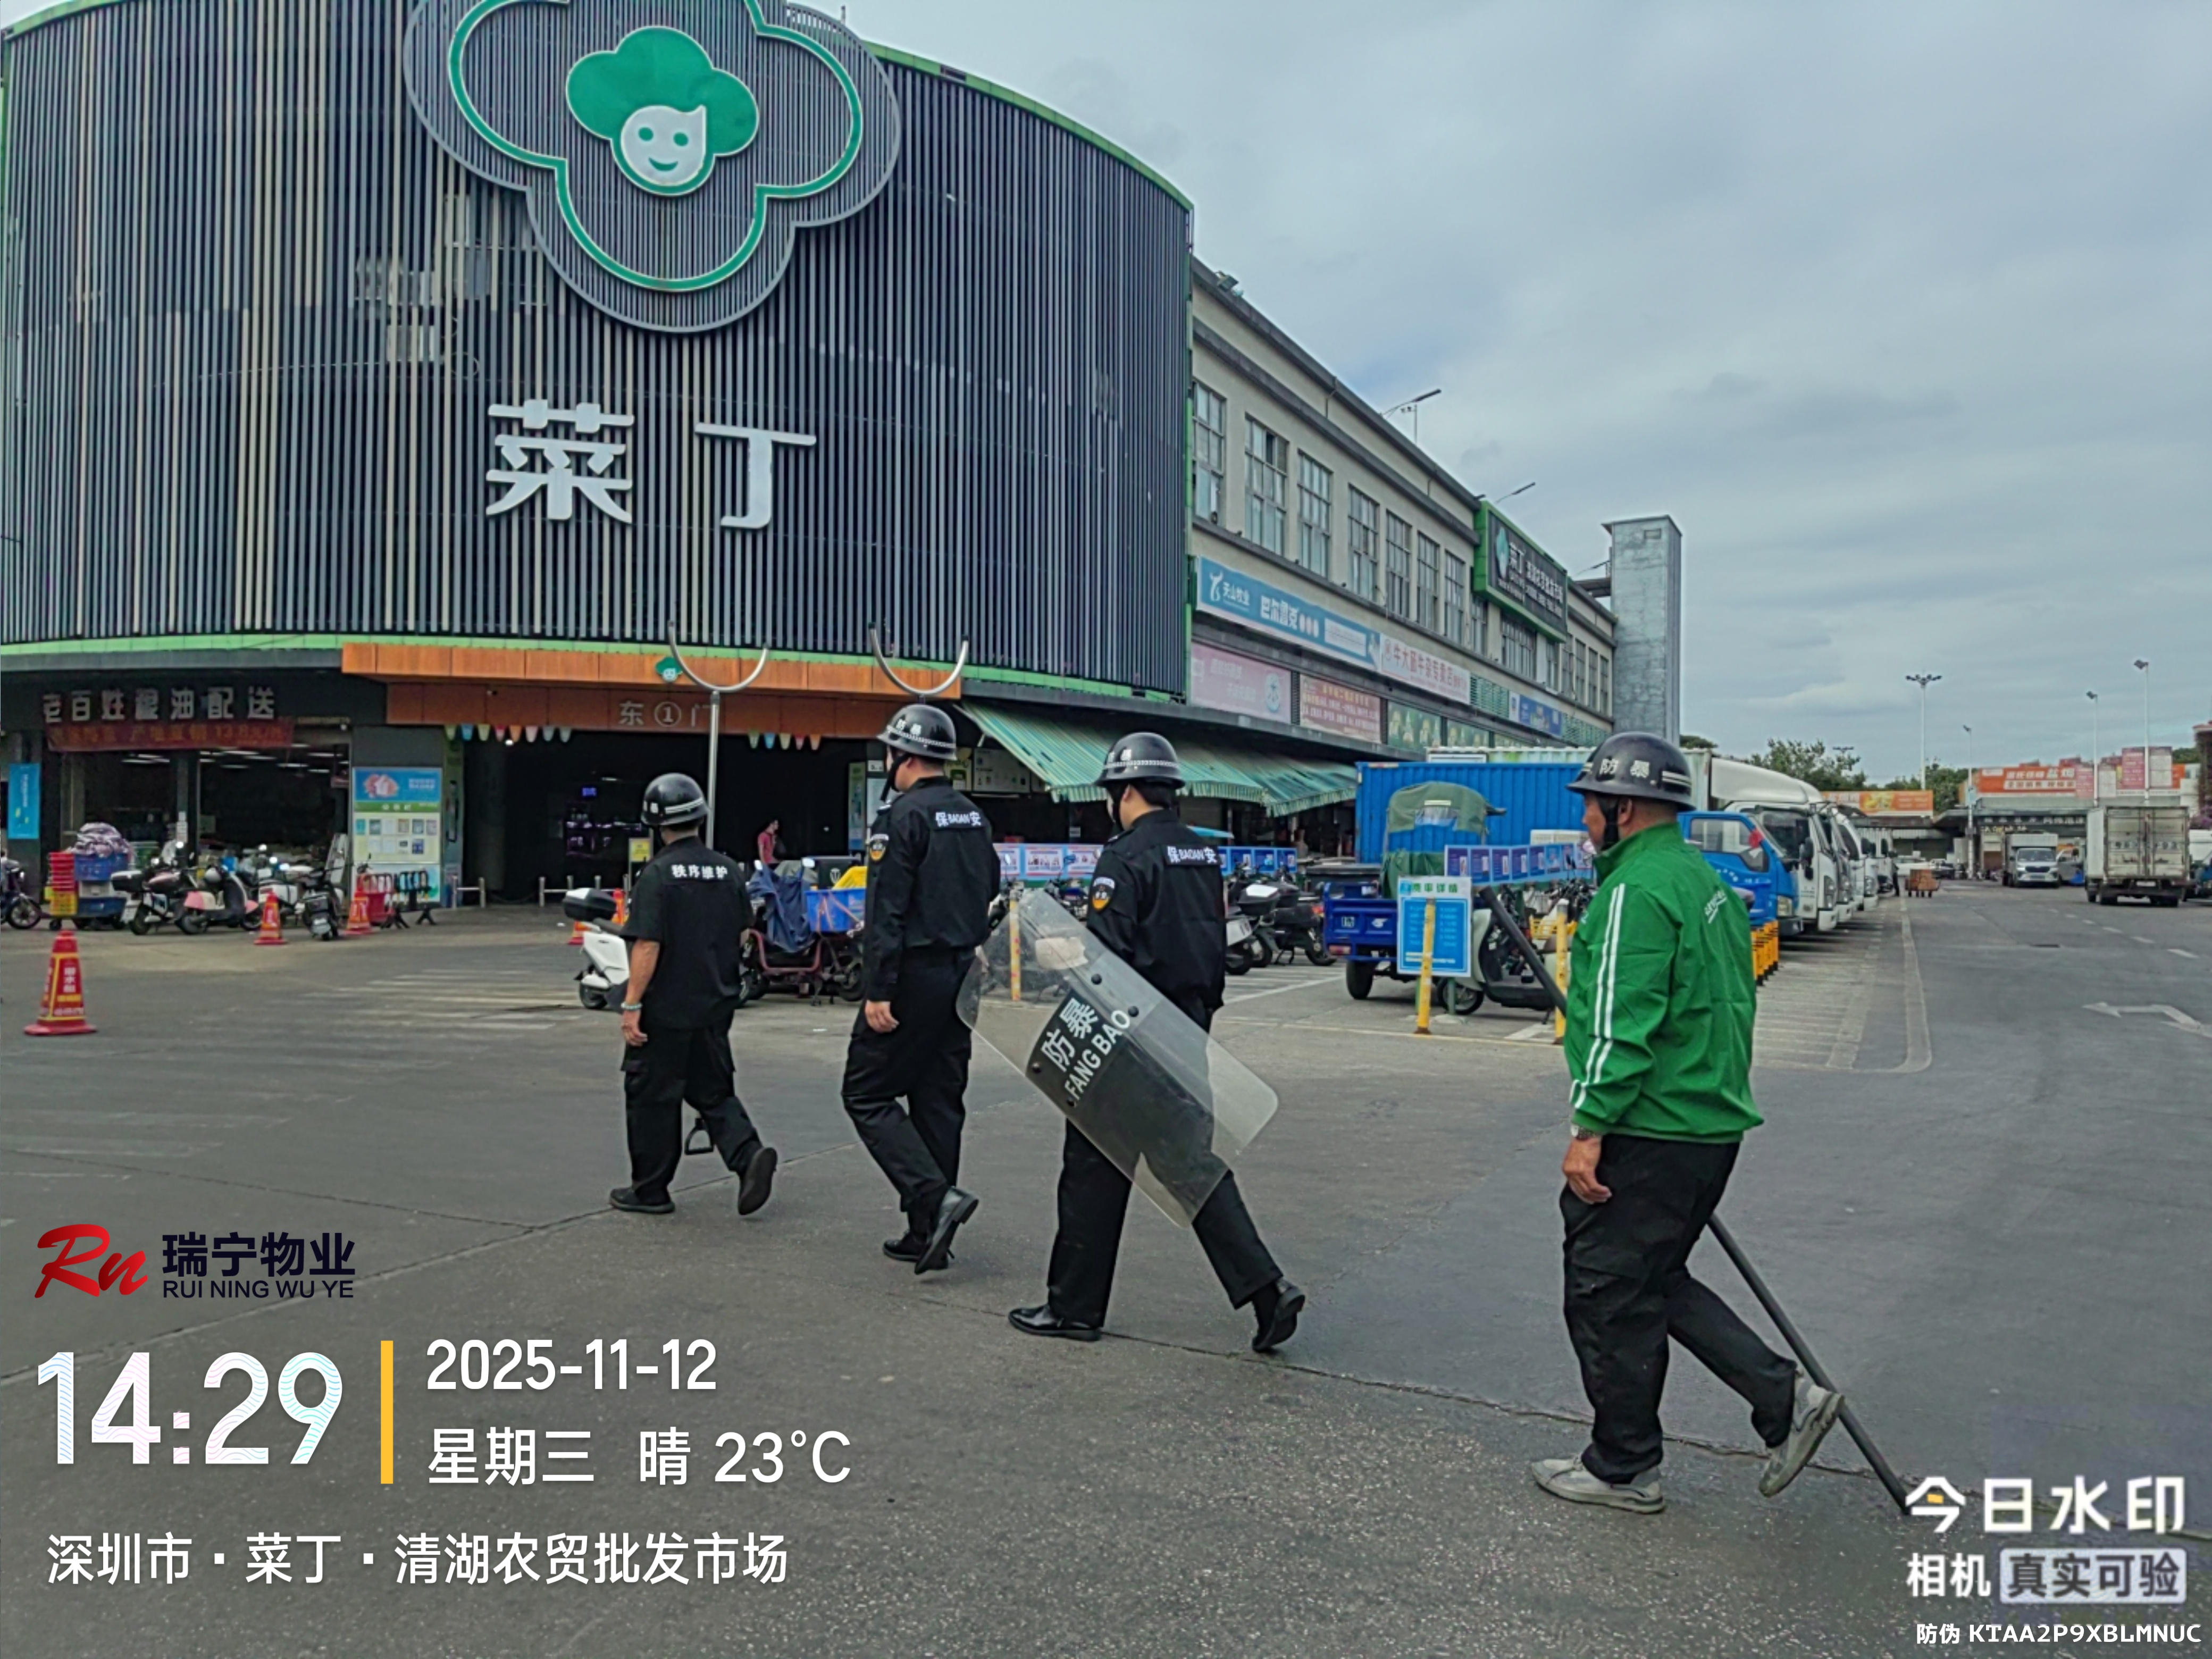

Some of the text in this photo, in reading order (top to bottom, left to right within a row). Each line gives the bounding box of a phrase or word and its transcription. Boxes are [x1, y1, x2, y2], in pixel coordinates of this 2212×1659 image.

[485, 399, 817, 529] 菜丁
[1599, 758, 1650, 779] 防暴
[671, 864, 728, 880] 秩序维护
[1040, 998, 1099, 1073] 防暴
[1065, 1010, 1130, 1100] FANG BAO
